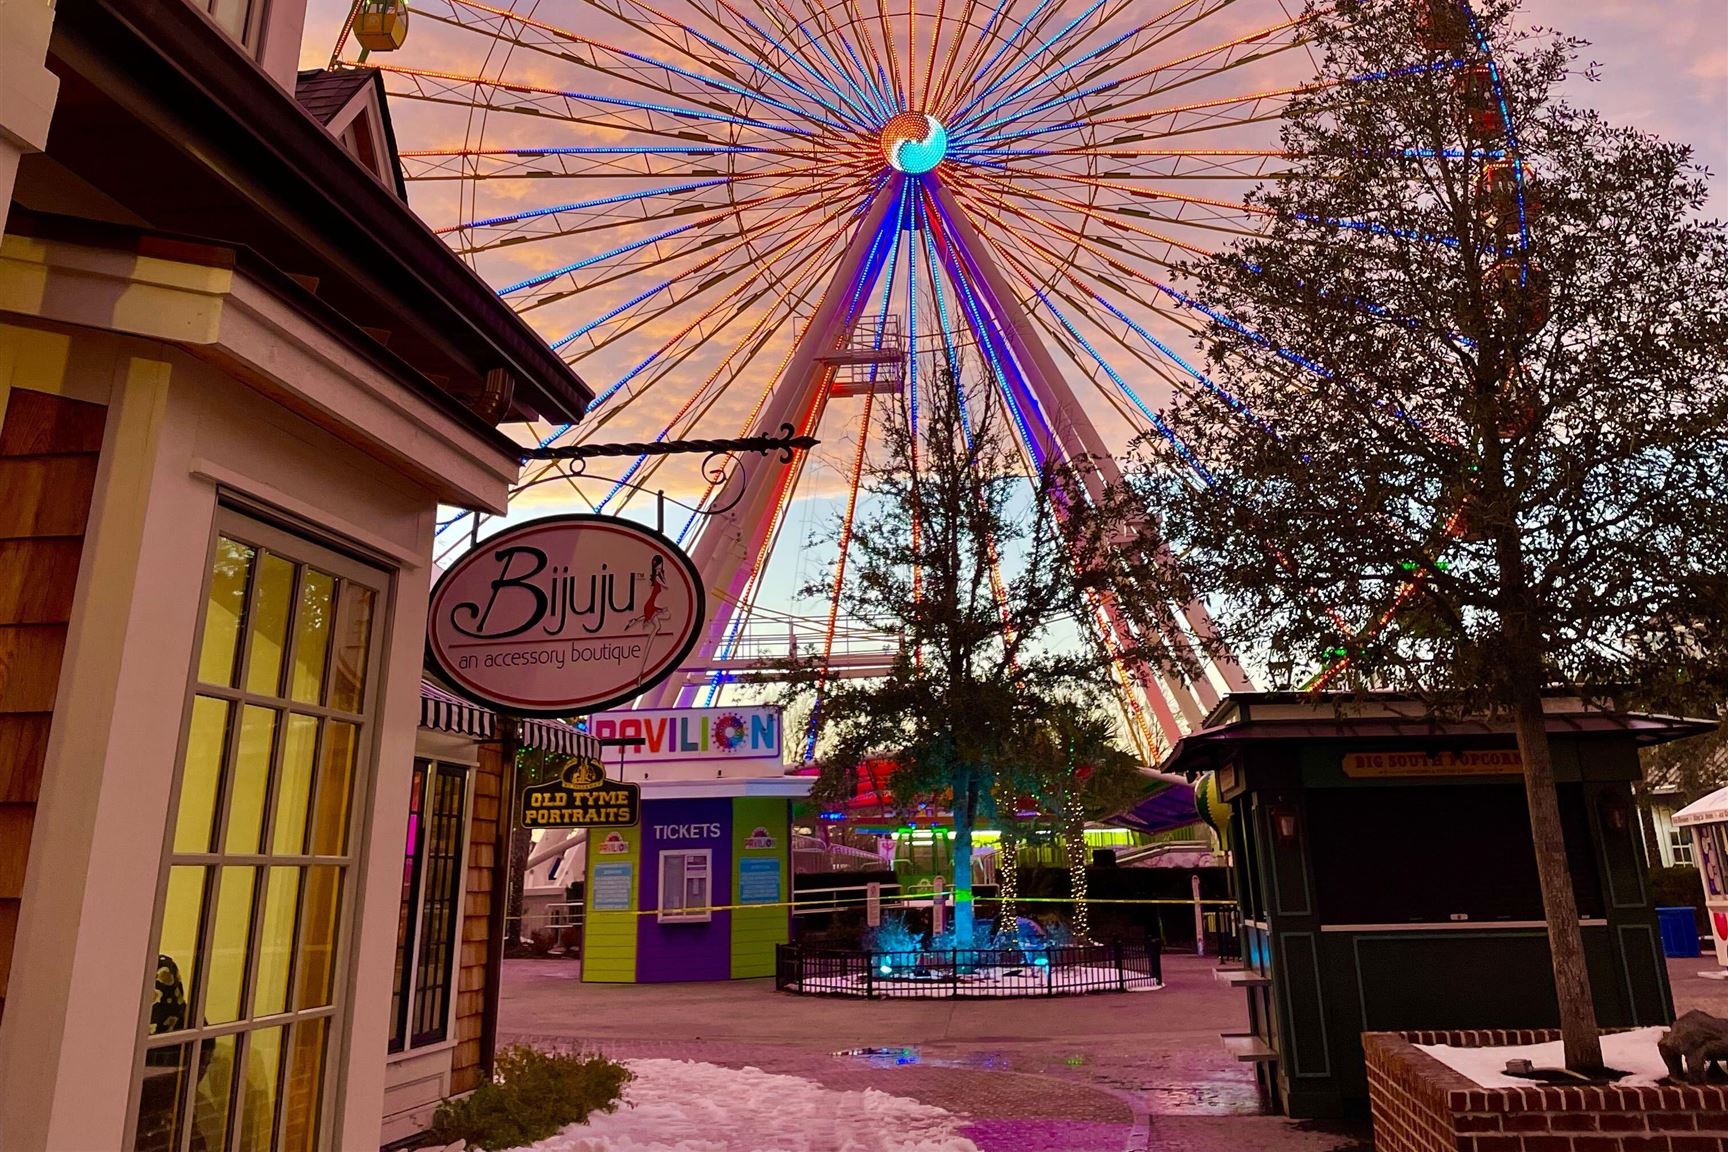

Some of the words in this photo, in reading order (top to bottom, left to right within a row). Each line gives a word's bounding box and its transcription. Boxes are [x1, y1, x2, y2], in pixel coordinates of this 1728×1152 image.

[450, 546, 635, 639] Bijuju
[459, 654, 478, 669] an
[484, 647, 565, 669] accessory
[571, 642, 641, 665] boutique
[596, 713, 774, 754] PAVILION
[1356, 755, 1383, 768] BIG
[531, 792, 567, 807] OLD
[573, 791, 629, 805] TYME
[525, 808, 631, 824] PORTRAITS
[654, 823, 721, 839] TICKETS
